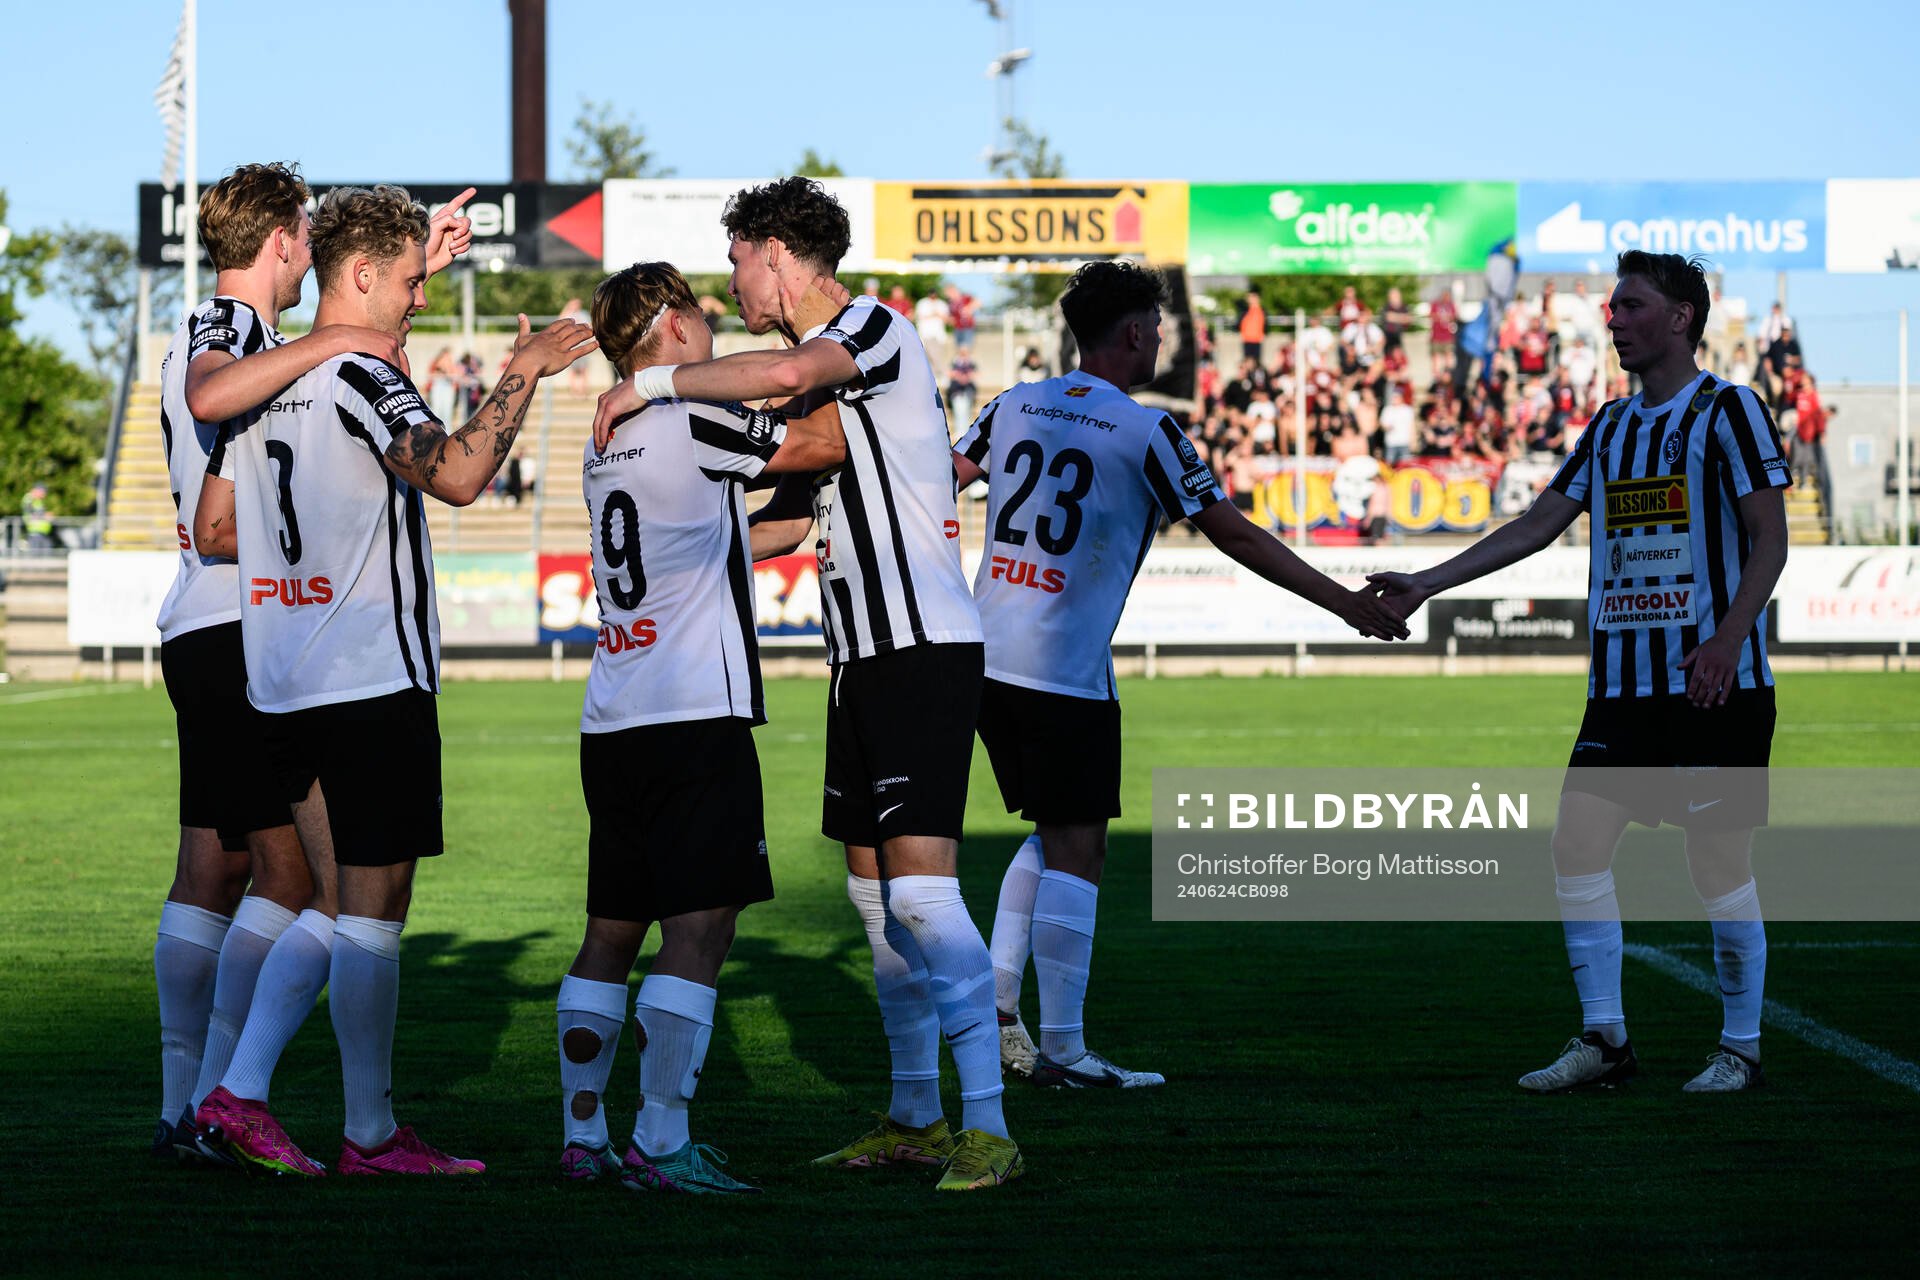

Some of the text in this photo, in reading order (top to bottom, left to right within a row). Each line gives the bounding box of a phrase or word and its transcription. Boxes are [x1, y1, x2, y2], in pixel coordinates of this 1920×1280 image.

[917, 208, 1106, 243] OHLSSONS
[1296, 203, 1431, 245] alfdex
[1609, 212, 1808, 251] emrahus
[192, 328, 235, 348] UNIBET
[1020, 403, 1118, 433] Kundpartner
[993, 439, 1094, 556] 23
[1626, 549, 1681, 562] NÄTVERKET
[250, 576, 334, 608] PULS
[1604, 590, 1690, 613] FLYTGOLV
[1608, 611, 1671, 624] LANDSKRONA
[1674, 609, 1689, 620] AB
